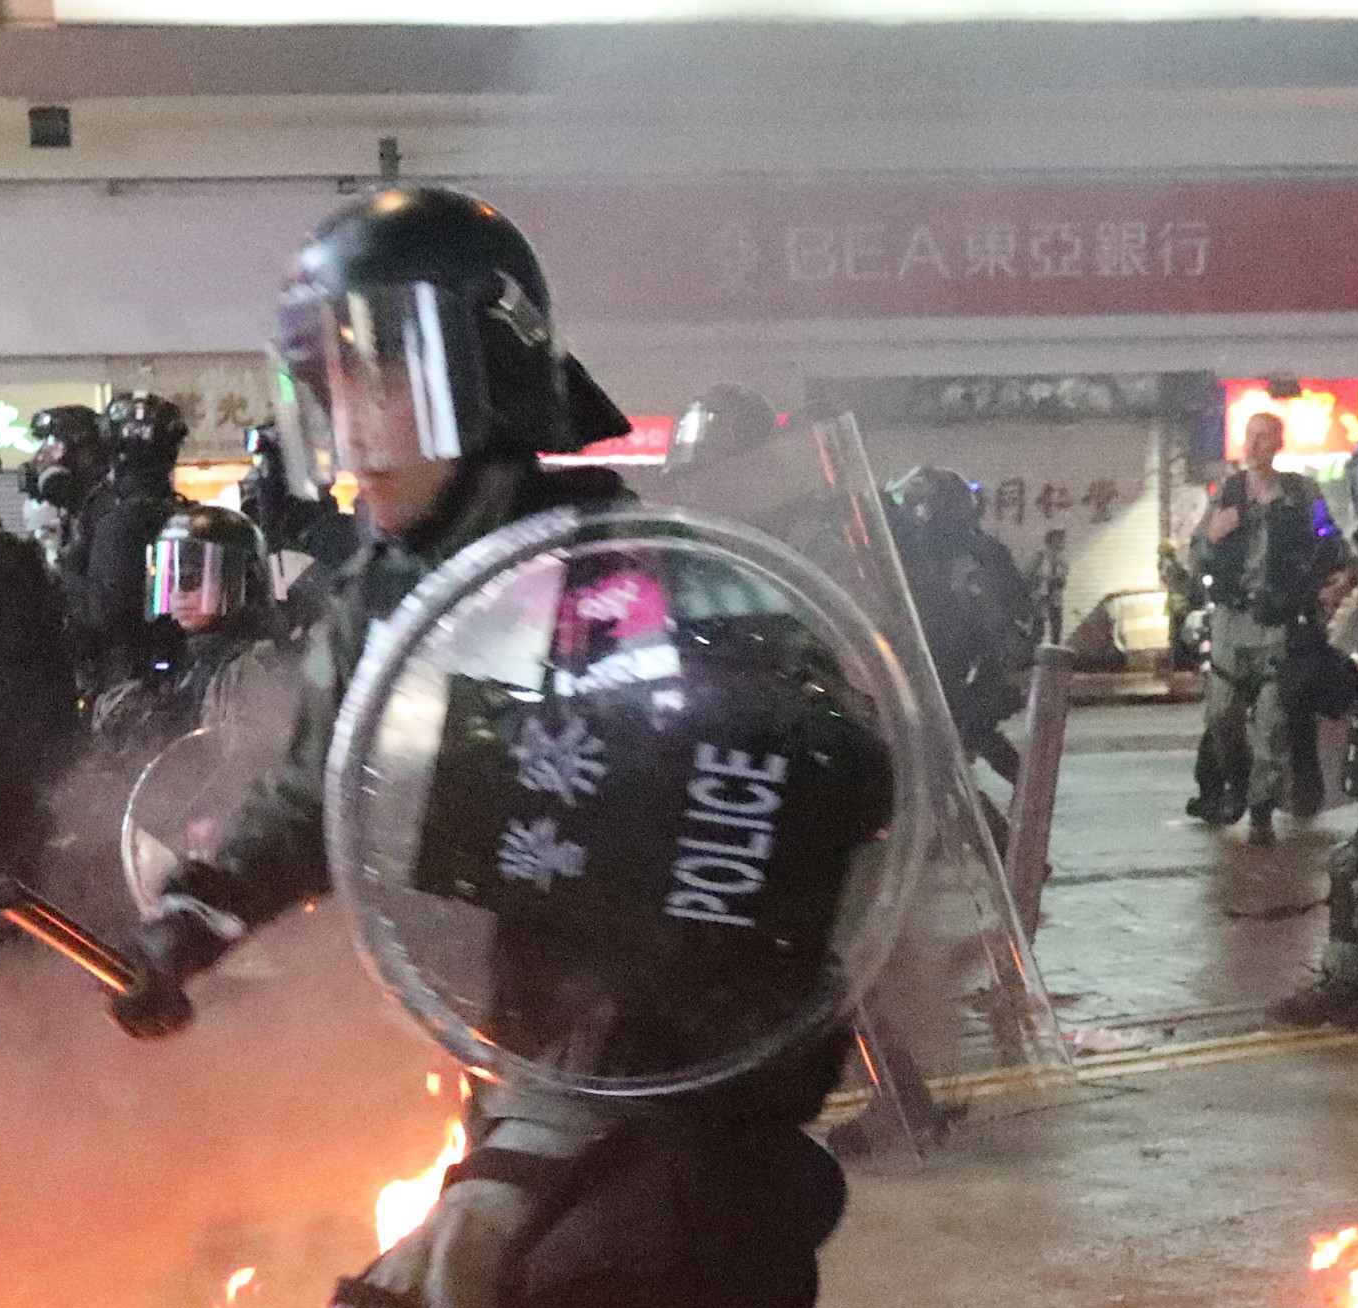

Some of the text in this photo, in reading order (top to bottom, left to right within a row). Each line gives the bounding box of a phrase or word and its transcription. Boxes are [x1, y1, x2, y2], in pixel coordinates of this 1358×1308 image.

[787, 219, 1213, 281] BEA 東亞銀行
[664, 742, 788, 928] POLICE
